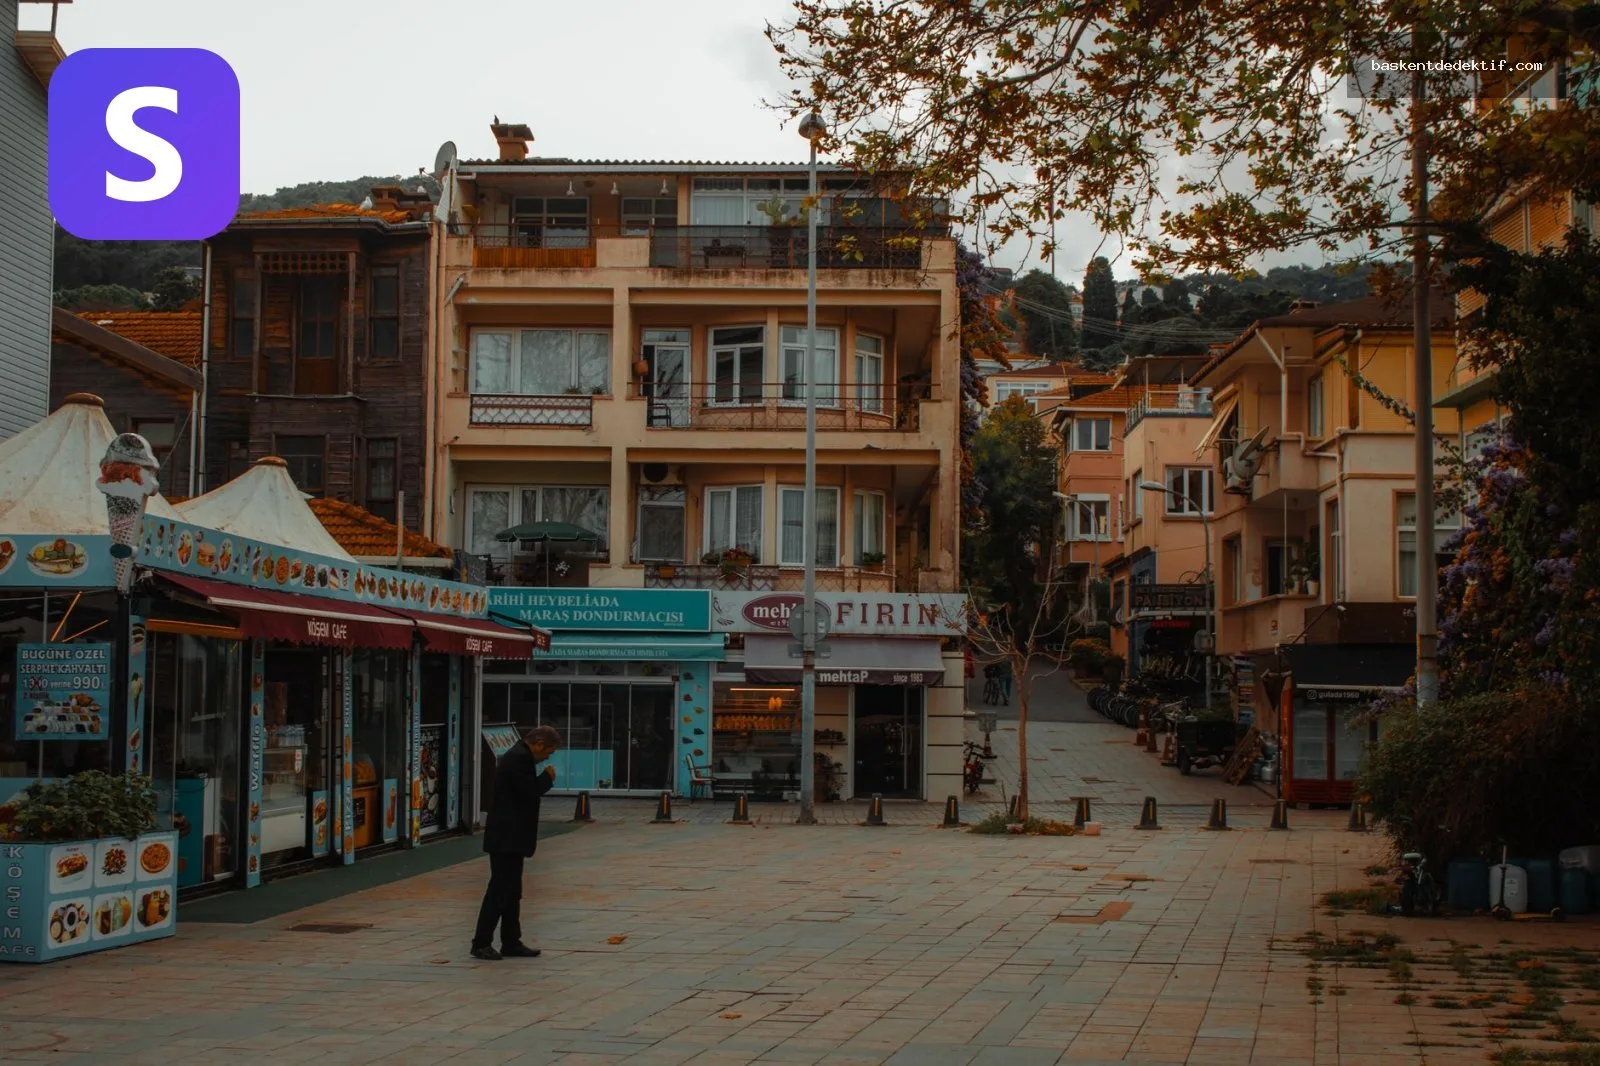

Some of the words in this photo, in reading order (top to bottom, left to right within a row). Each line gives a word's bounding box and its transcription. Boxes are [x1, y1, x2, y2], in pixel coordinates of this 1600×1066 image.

[488, 592, 524, 606] RİHİ
[528, 593, 620, 607] HEYBELİADA
[519, 609, 570, 624] MARAŞ
[836, 602, 938, 625] FIRIN
[332, 623, 347, 640] CAFE
[22, 647, 73, 660] BUGÜNE
[75, 647, 106, 660] ÖZEL
[20, 664, 55, 674] SERPME
[57, 664, 107, 674] KAHVALTI
[73, 676, 101, 689] 990
[0, 945, 36, 957] AFE
